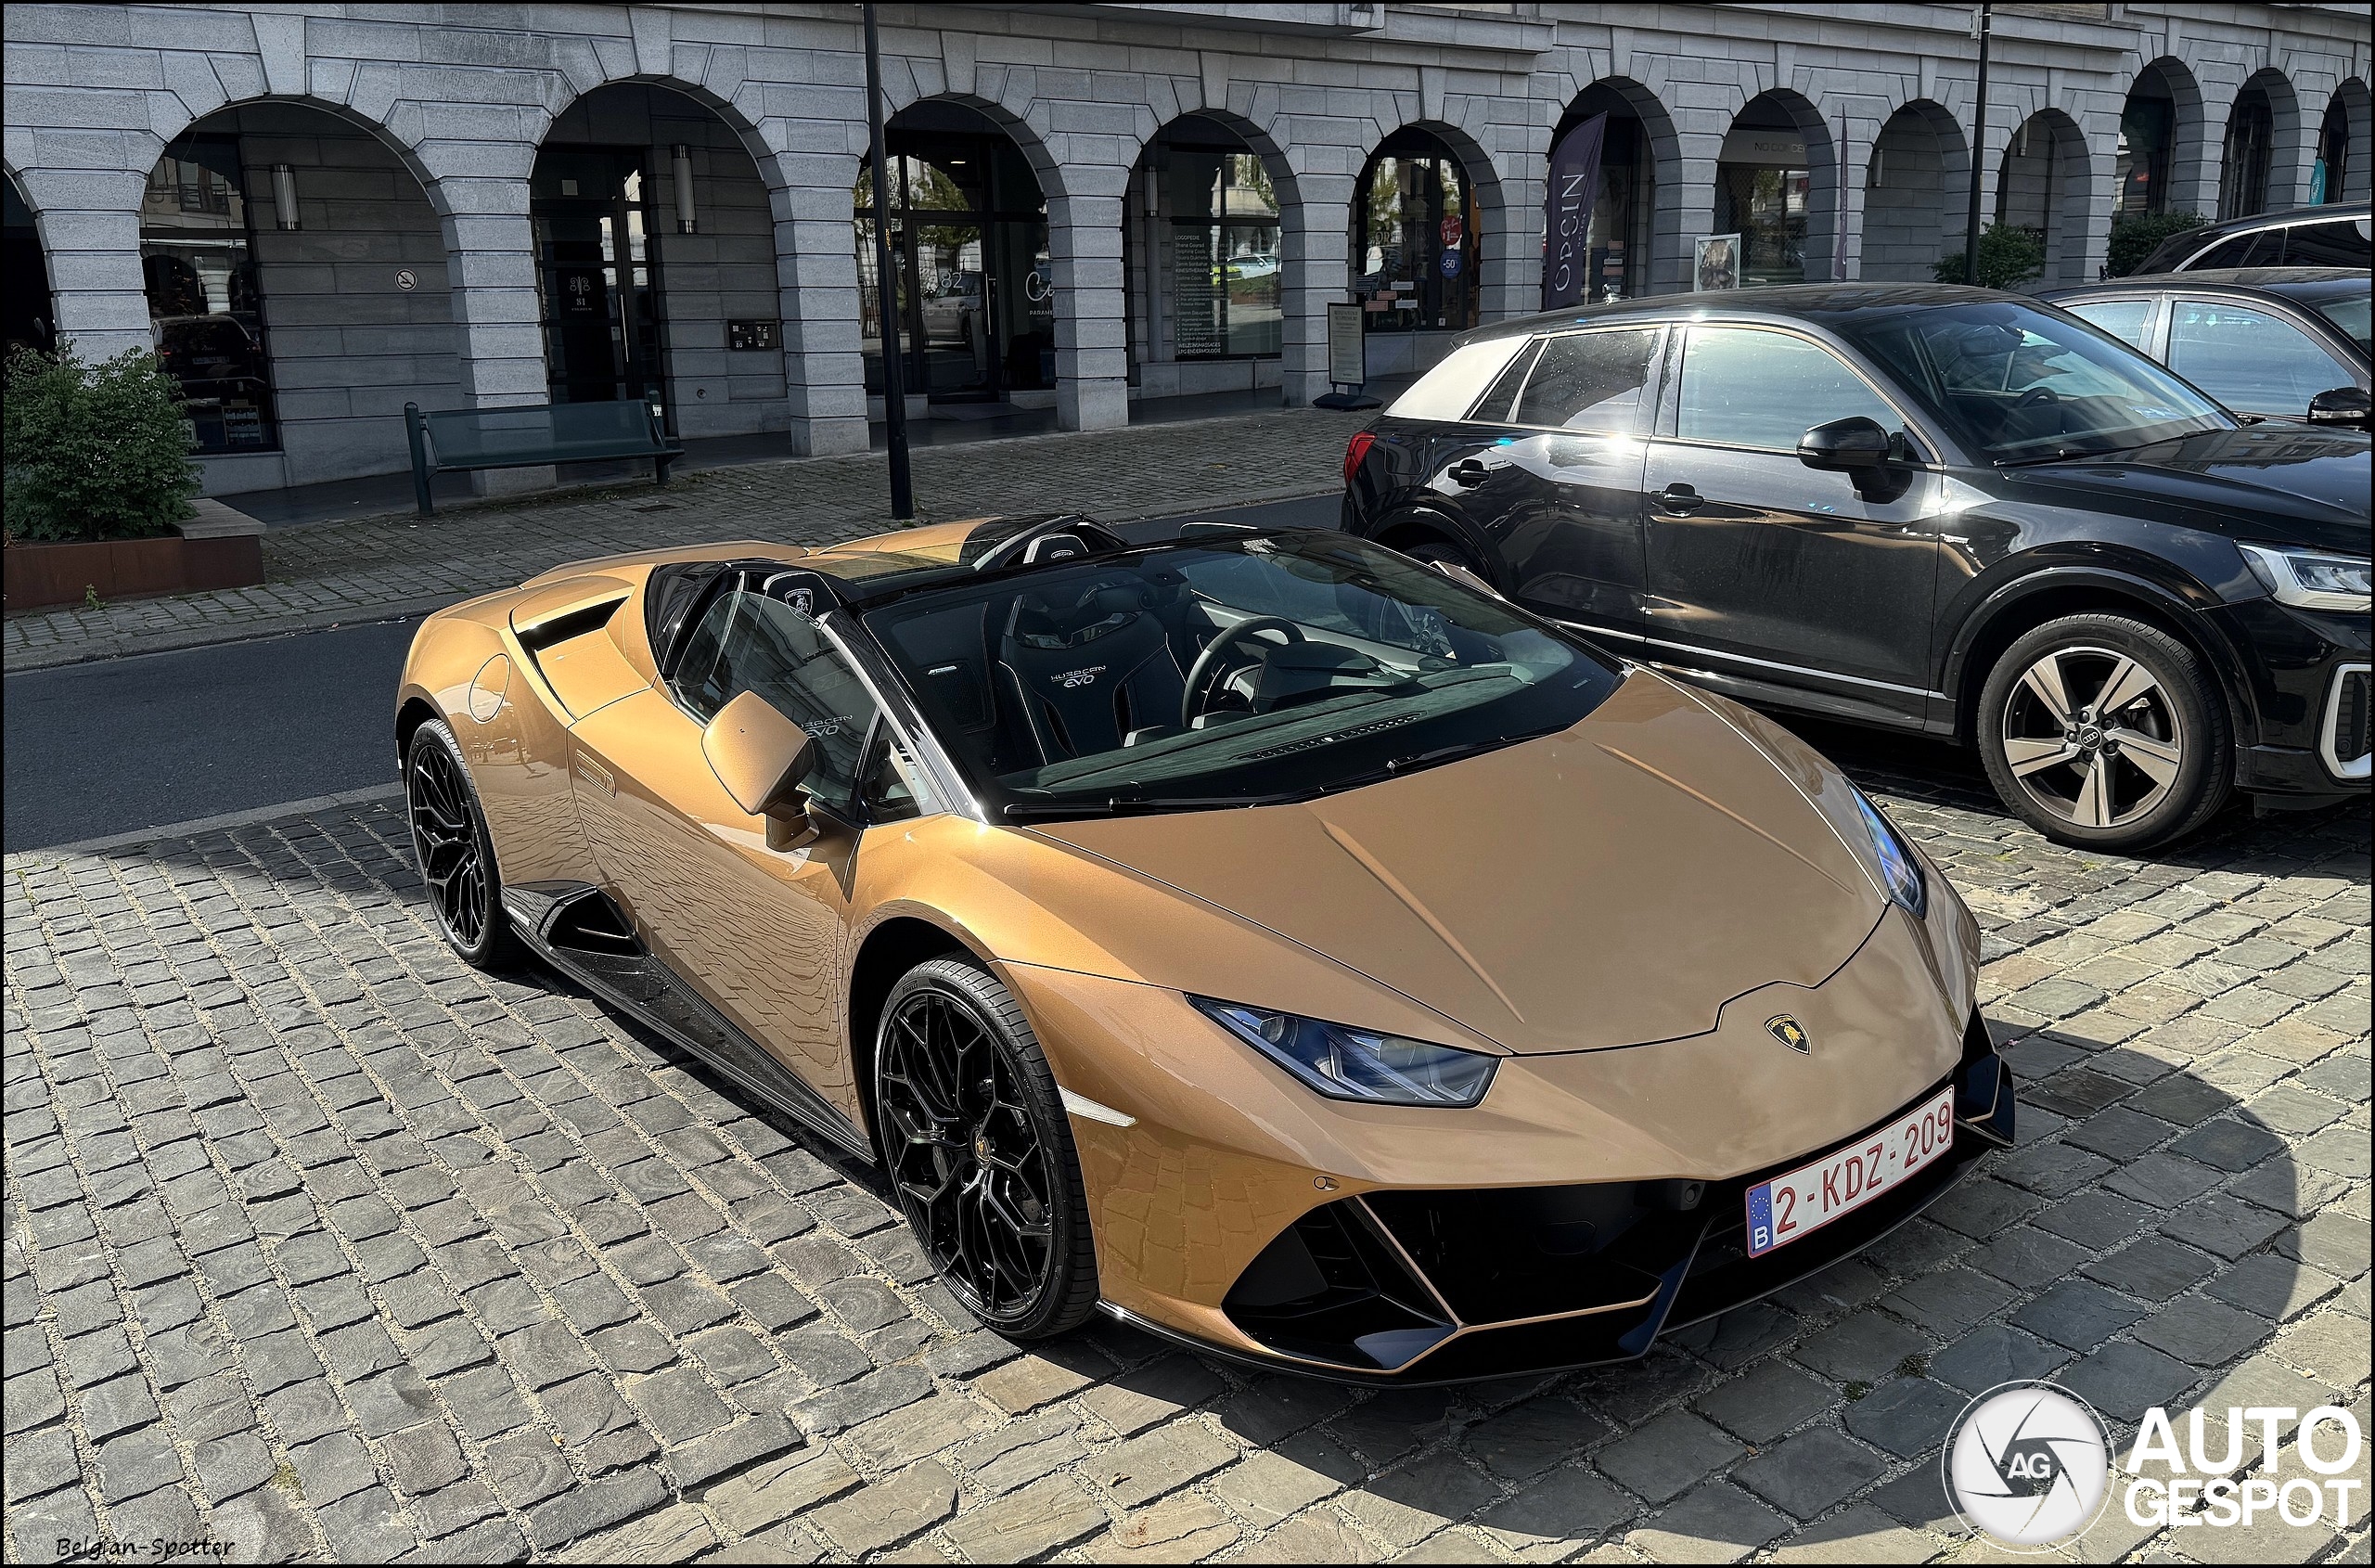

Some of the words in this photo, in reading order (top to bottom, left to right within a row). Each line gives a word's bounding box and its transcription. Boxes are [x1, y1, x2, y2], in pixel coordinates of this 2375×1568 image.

[941, 271, 964, 289] 82
[1063, 675, 1096, 688] EVO
[805, 725, 840, 739] EVO
[1775, 1100, 1951, 1235] 2-KDZ-209
[1753, 1225, 1769, 1250] B
